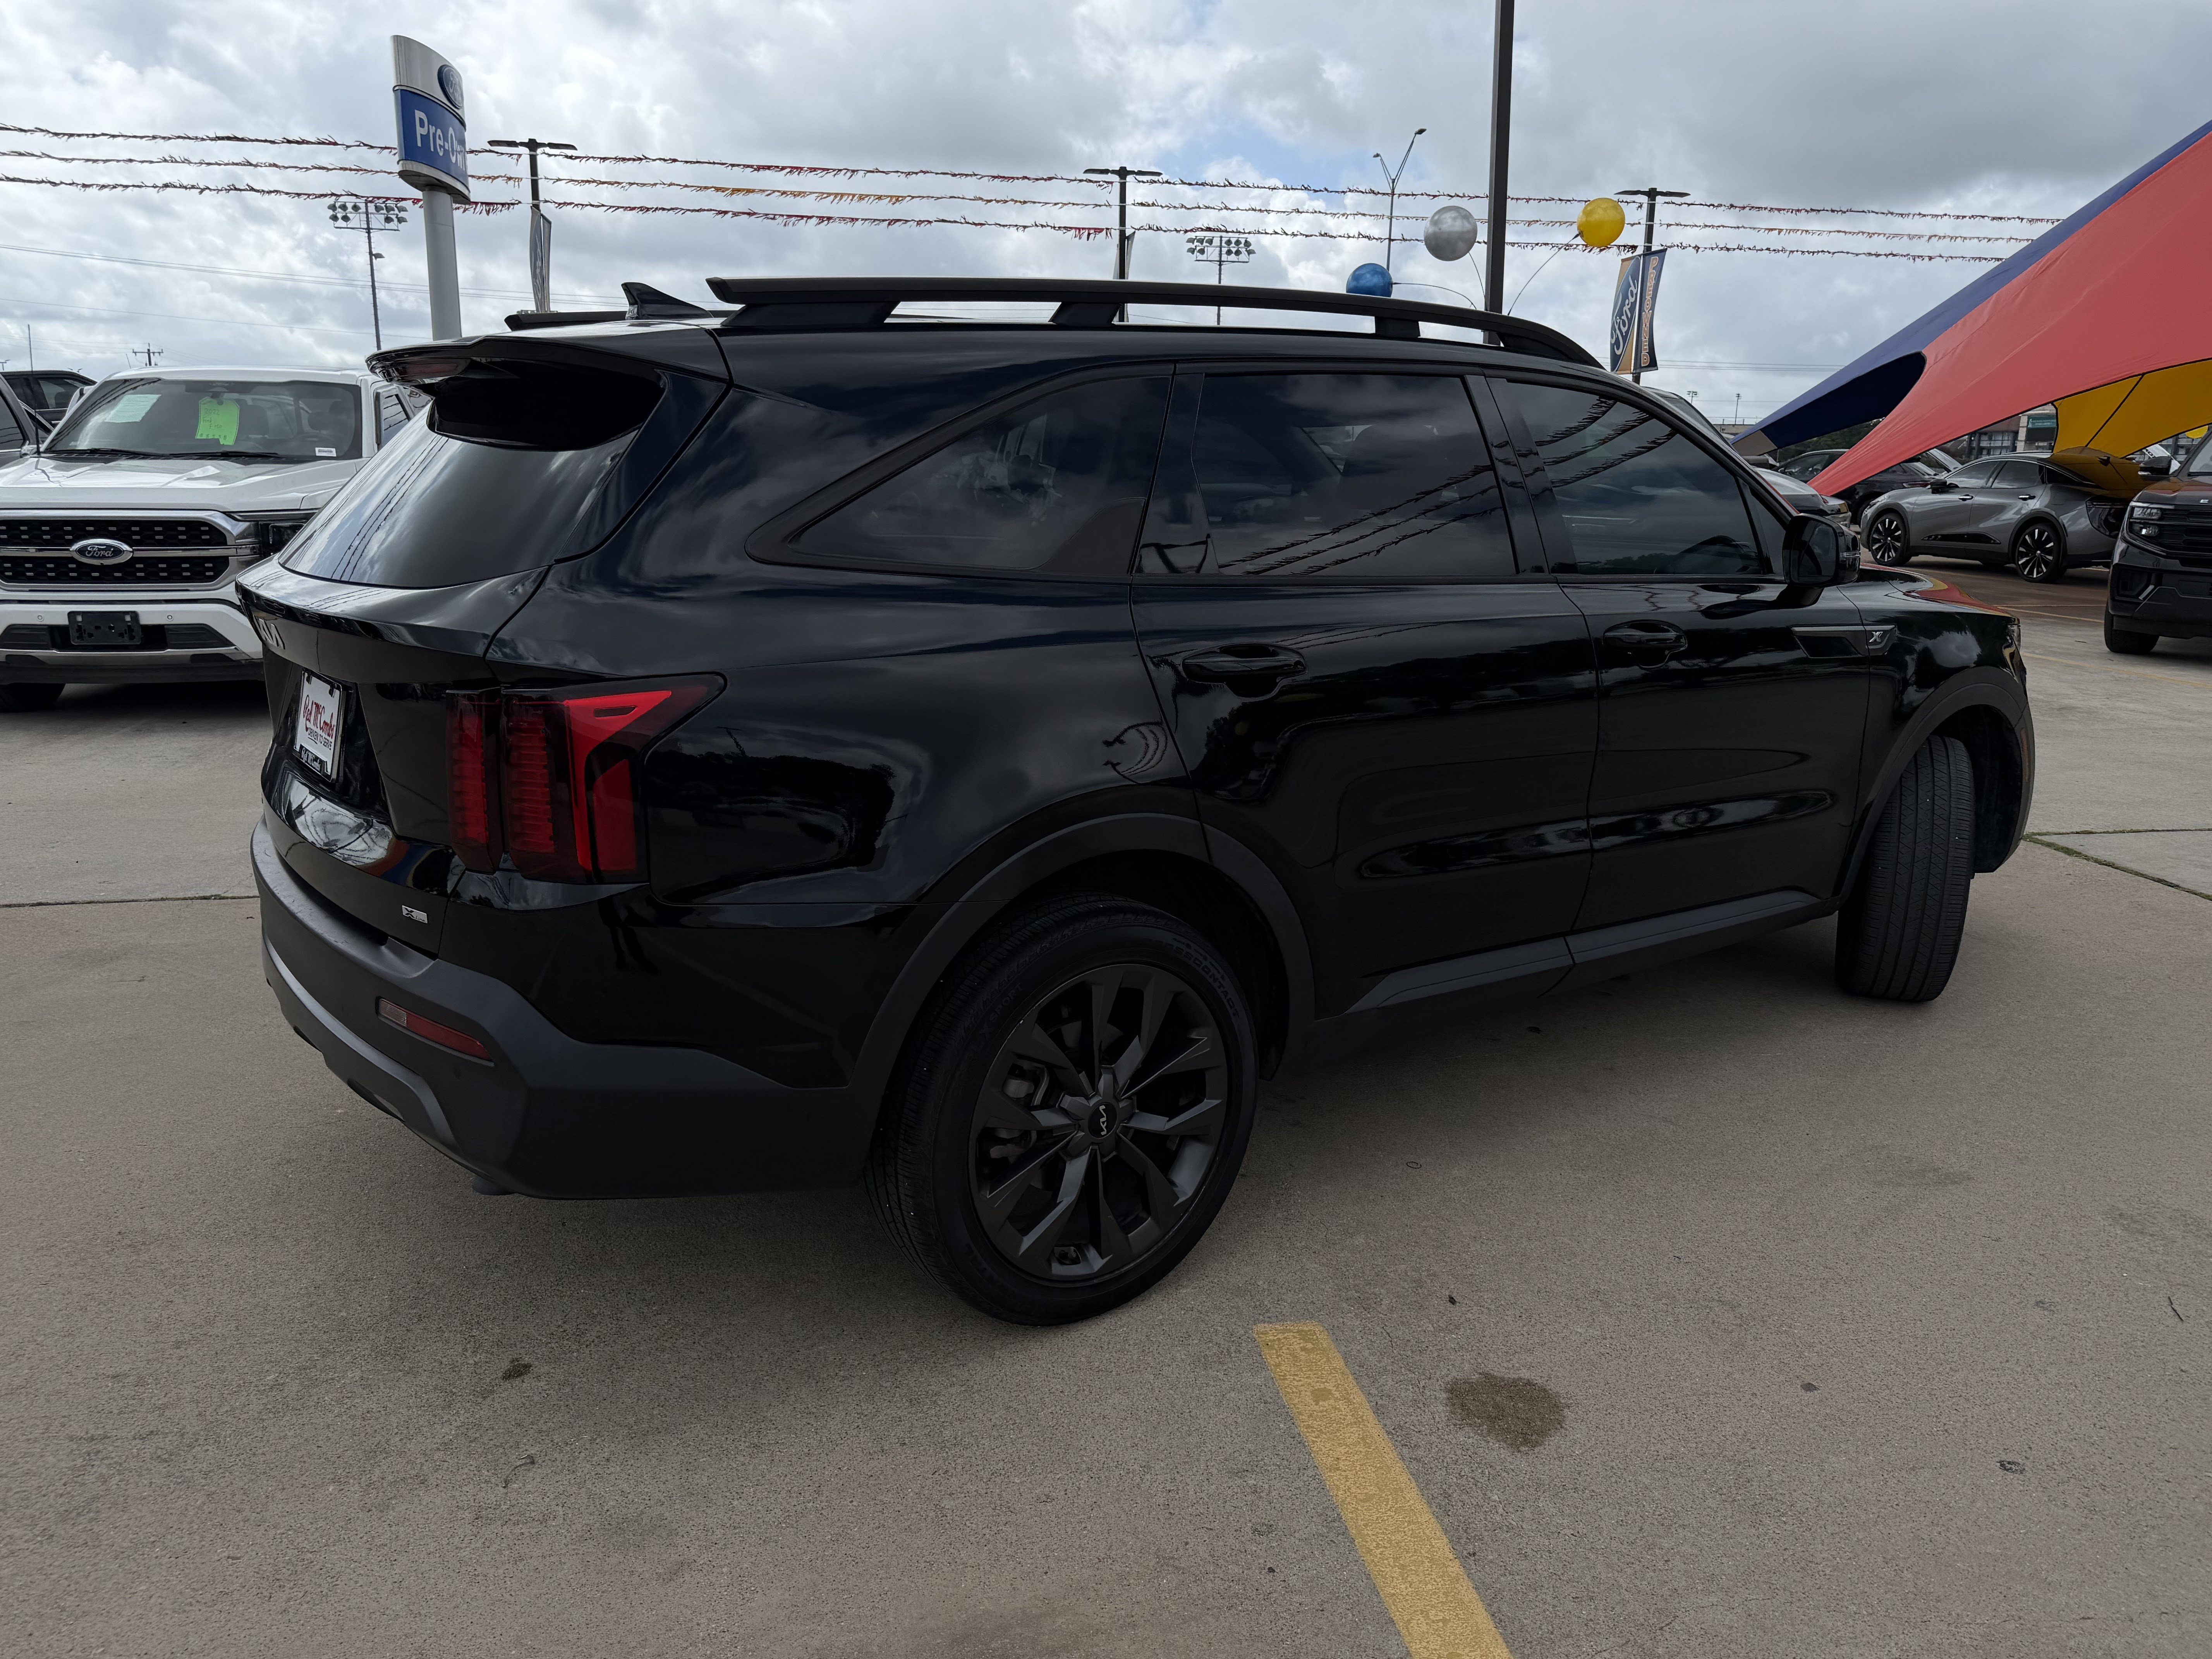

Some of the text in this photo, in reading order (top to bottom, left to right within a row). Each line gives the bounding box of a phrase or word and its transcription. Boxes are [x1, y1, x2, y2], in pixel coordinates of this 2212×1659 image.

[1611, 275, 1637, 355] Ford
[86, 545, 113, 556] Ford
[303, 694, 313, 732] Red
